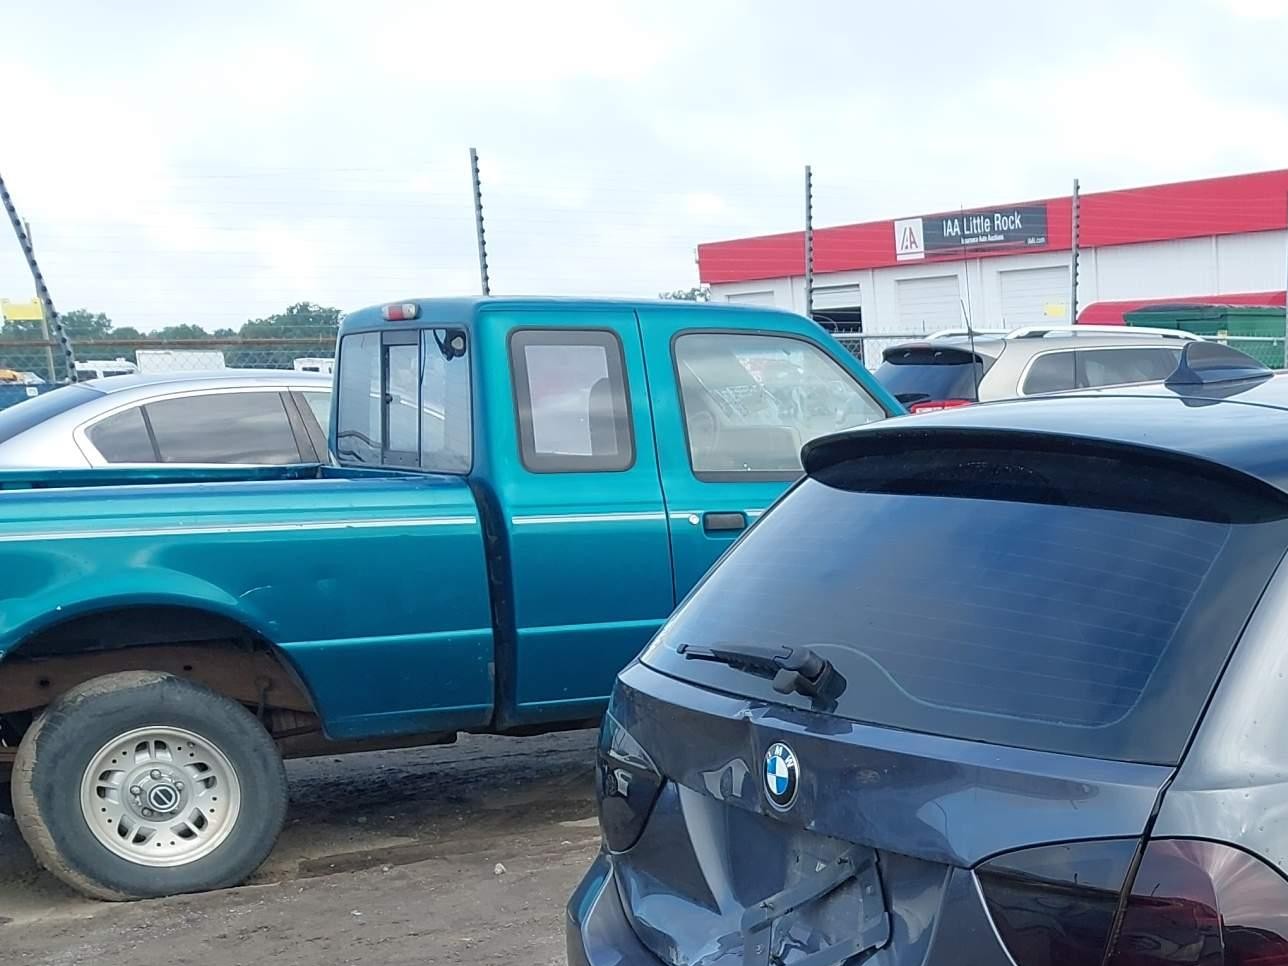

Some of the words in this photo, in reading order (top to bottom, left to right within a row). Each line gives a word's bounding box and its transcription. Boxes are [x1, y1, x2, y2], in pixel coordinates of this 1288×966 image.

[943, 218, 961, 237] IAA
[963, 215, 991, 235] Little
[994, 211, 1022, 232] Rock
